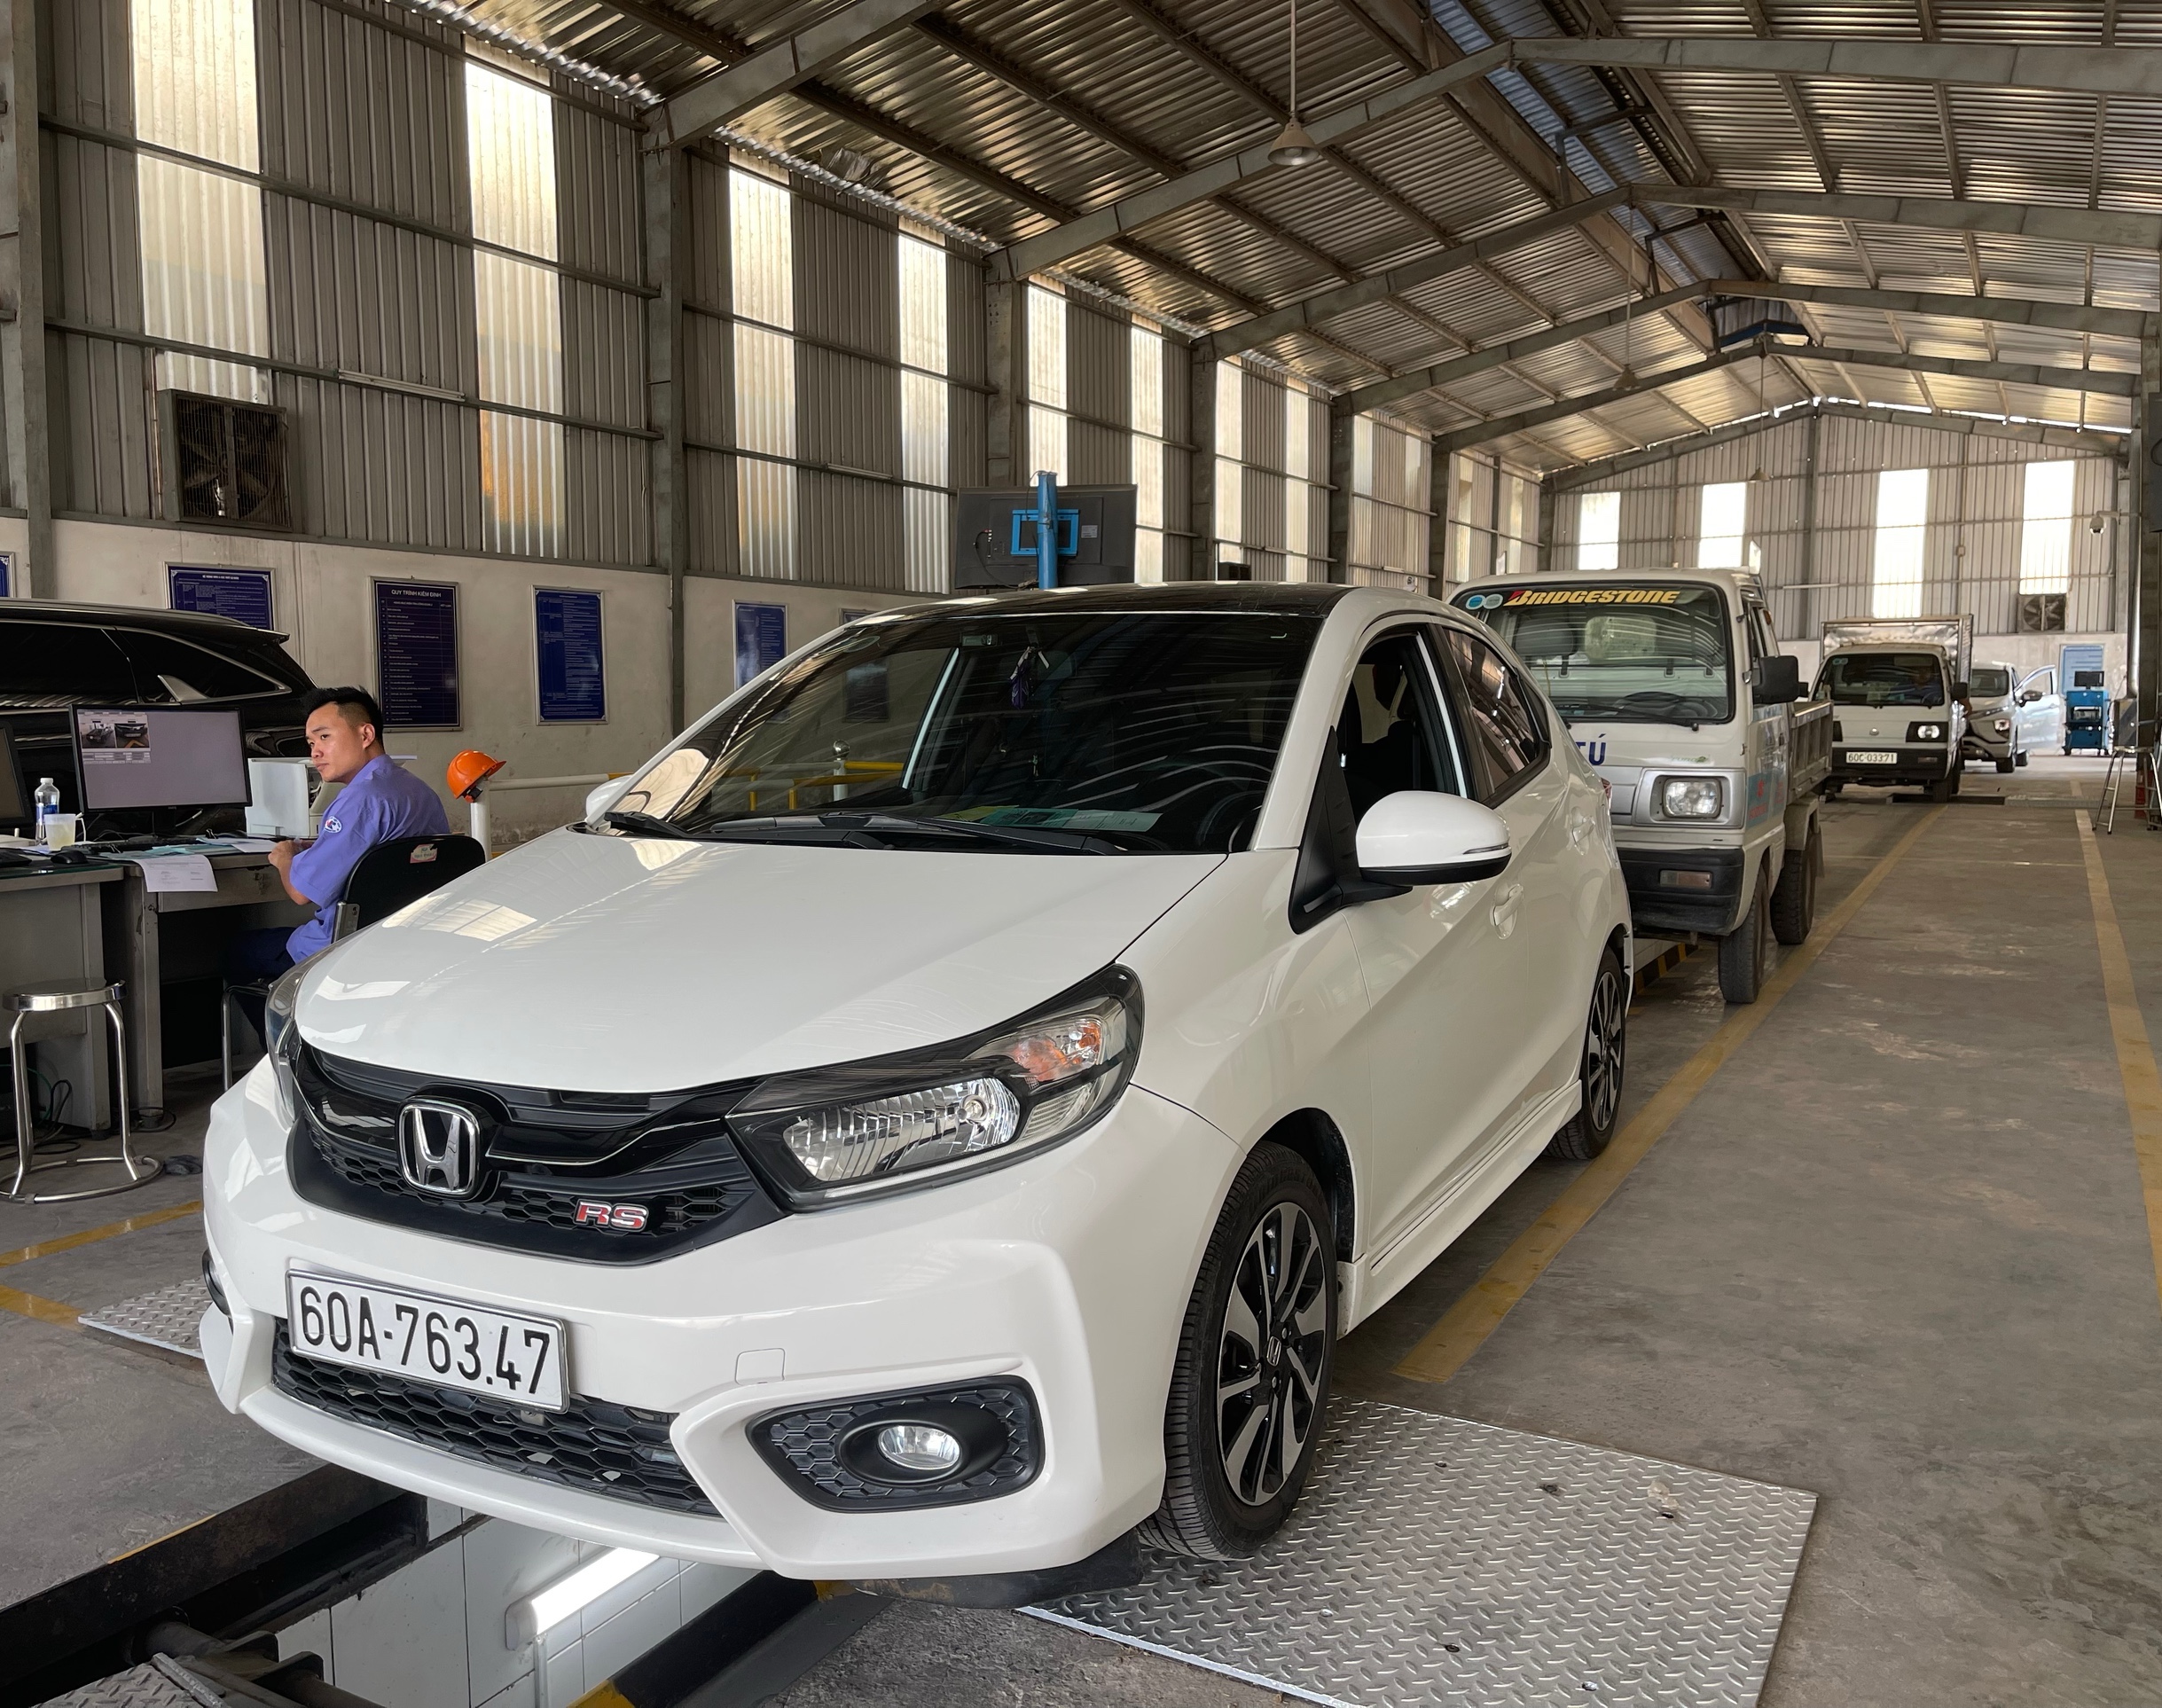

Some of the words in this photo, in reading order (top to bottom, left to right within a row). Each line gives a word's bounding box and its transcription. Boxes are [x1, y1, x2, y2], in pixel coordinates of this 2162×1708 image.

[1503, 589, 1680, 607] BRIDGESTONE
[574, 1199, 648, 1233] RS
[300, 1286, 551, 1395] 60A-763.47
